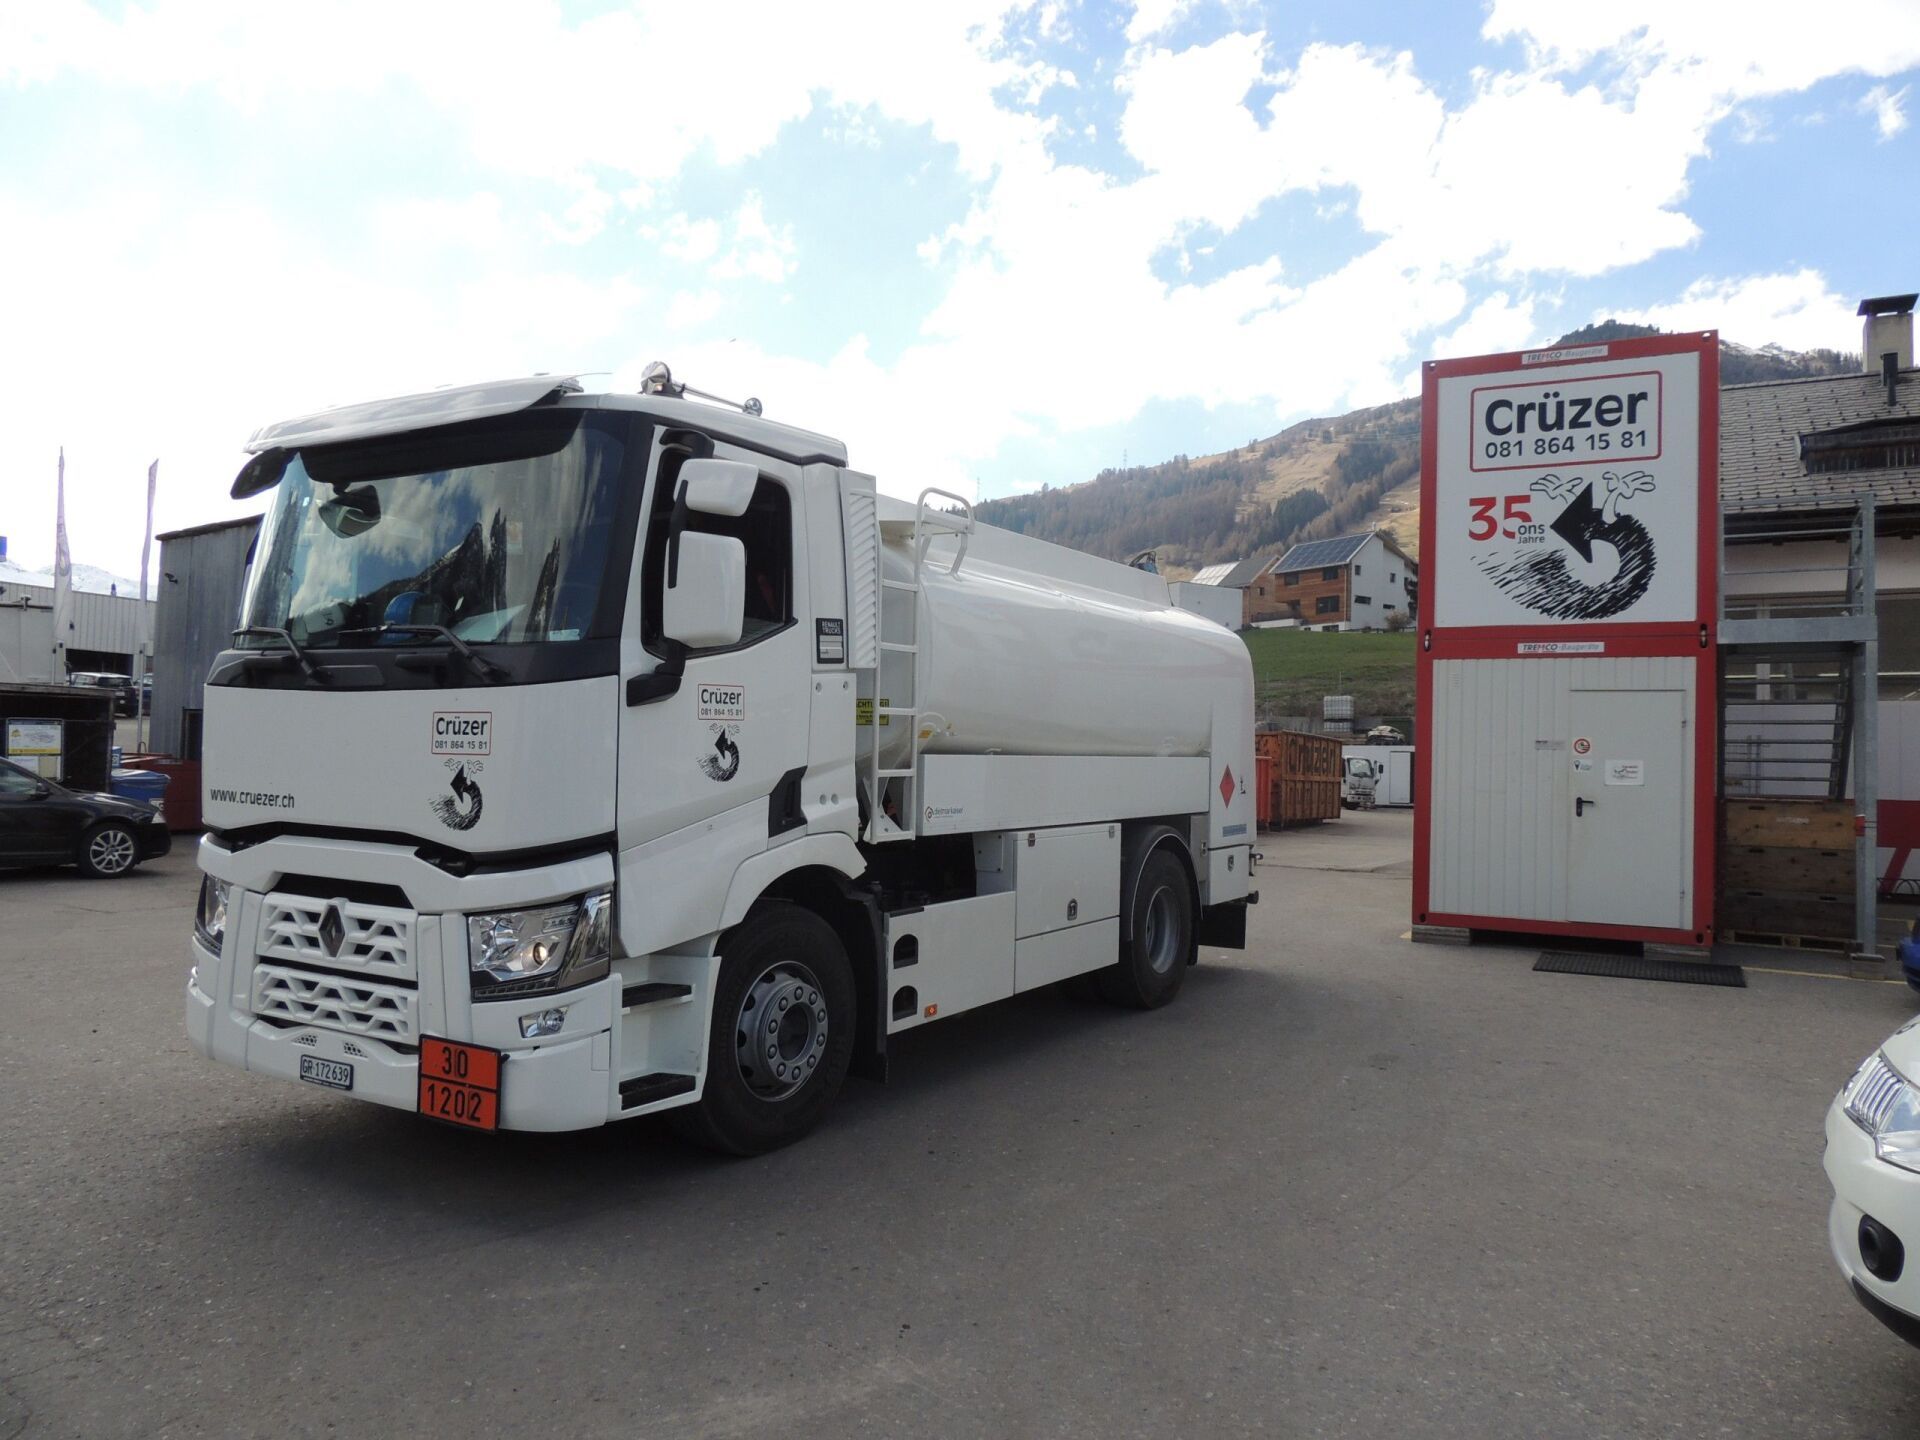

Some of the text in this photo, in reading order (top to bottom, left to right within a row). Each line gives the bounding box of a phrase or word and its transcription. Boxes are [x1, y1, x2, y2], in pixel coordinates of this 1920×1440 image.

[1485, 391, 1649, 436] Crüzer
[1485, 430, 1646, 459] 081 864 15 81
[1468, 494, 1532, 541] 35
[1518, 523, 1545, 535] ons
[1518, 535, 1545, 544] Jahre
[821, 620, 841, 628] RENAULT
[822, 627, 841, 635] TRUCKS
[1523, 643, 1558, 651] TREMCO
[701, 688, 742, 705] Crüzer
[701, 708, 712, 716] 081
[714, 708, 725, 716] 864
[436, 716, 488, 736] Crüzer
[435, 740, 488, 750] 081 864 15 81
[210, 788, 295, 808] www.cruezer.ch
[442, 1046, 468, 1078] 30
[428, 1083, 482, 1122] 1202
